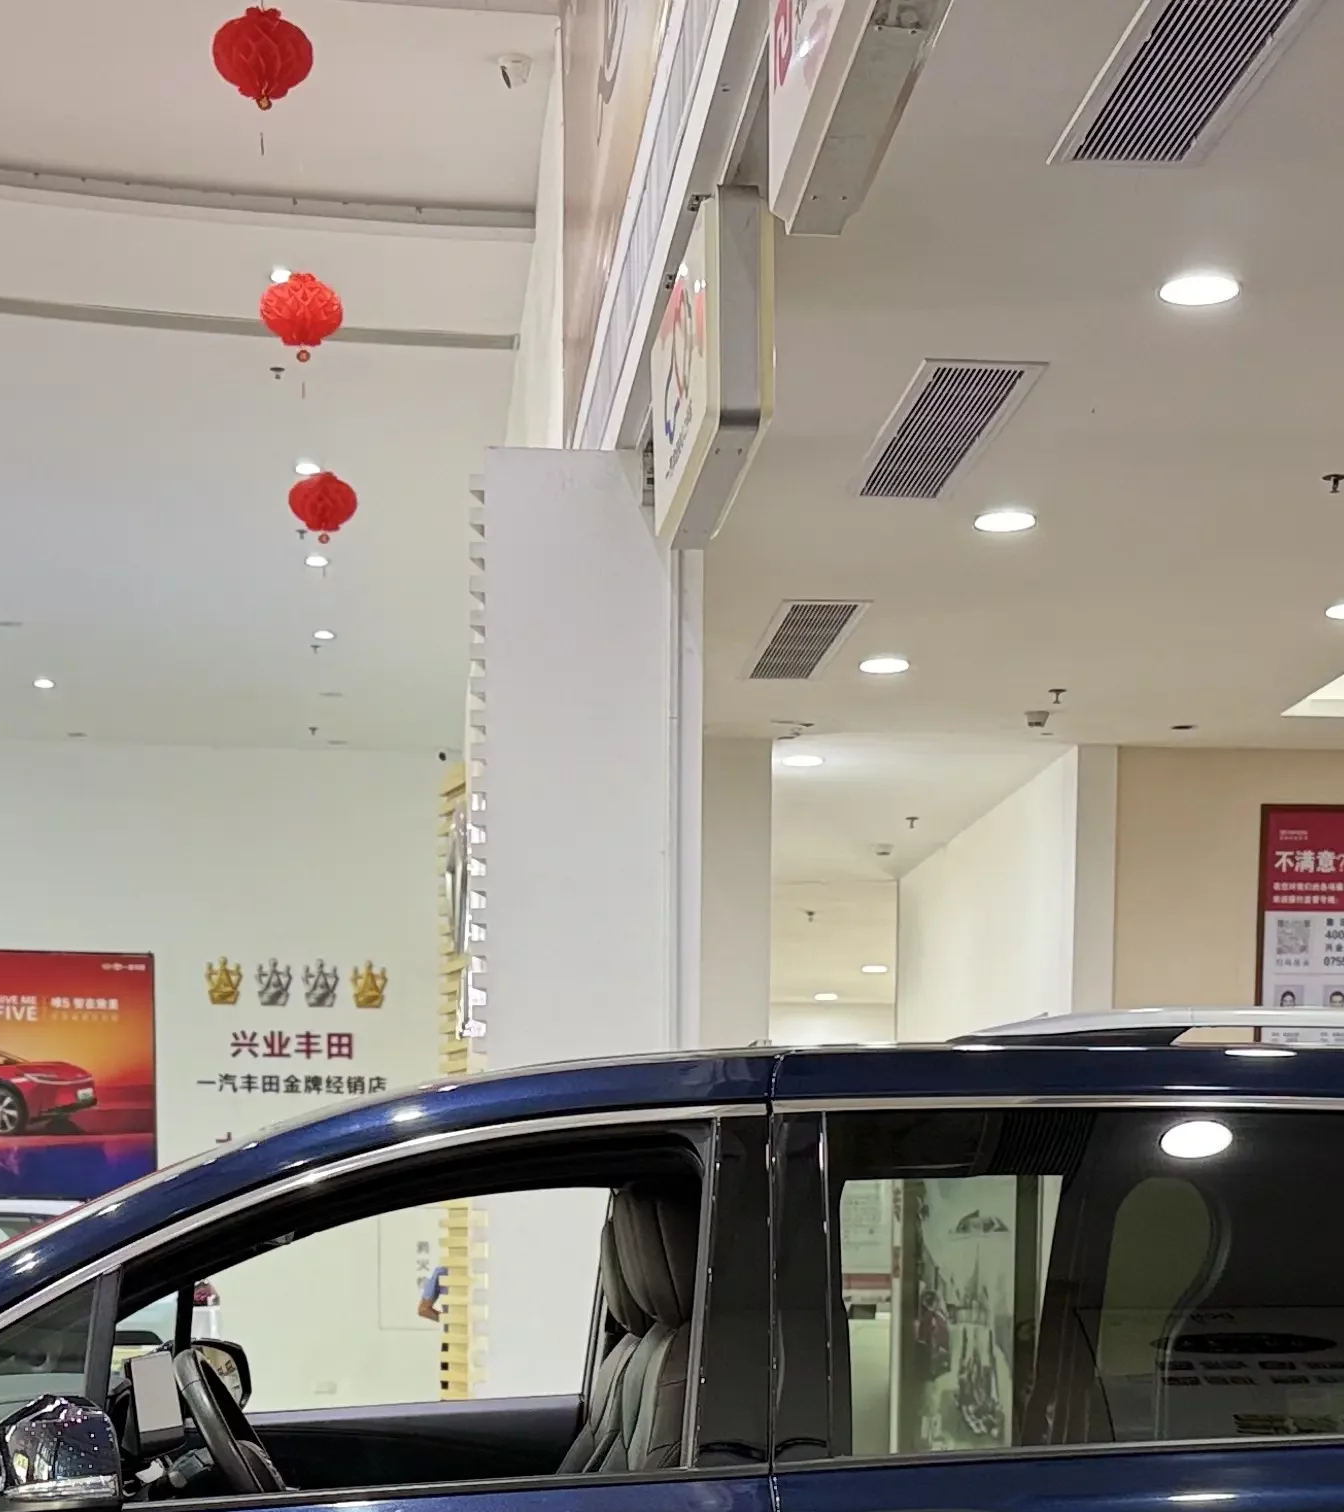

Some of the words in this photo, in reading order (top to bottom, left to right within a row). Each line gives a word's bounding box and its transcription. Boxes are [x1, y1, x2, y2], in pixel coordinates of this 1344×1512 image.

[230, 1030, 354, 1060] 兴业丰田
[196, 1073, 388, 1095] 一汽丰田金牌经销店
